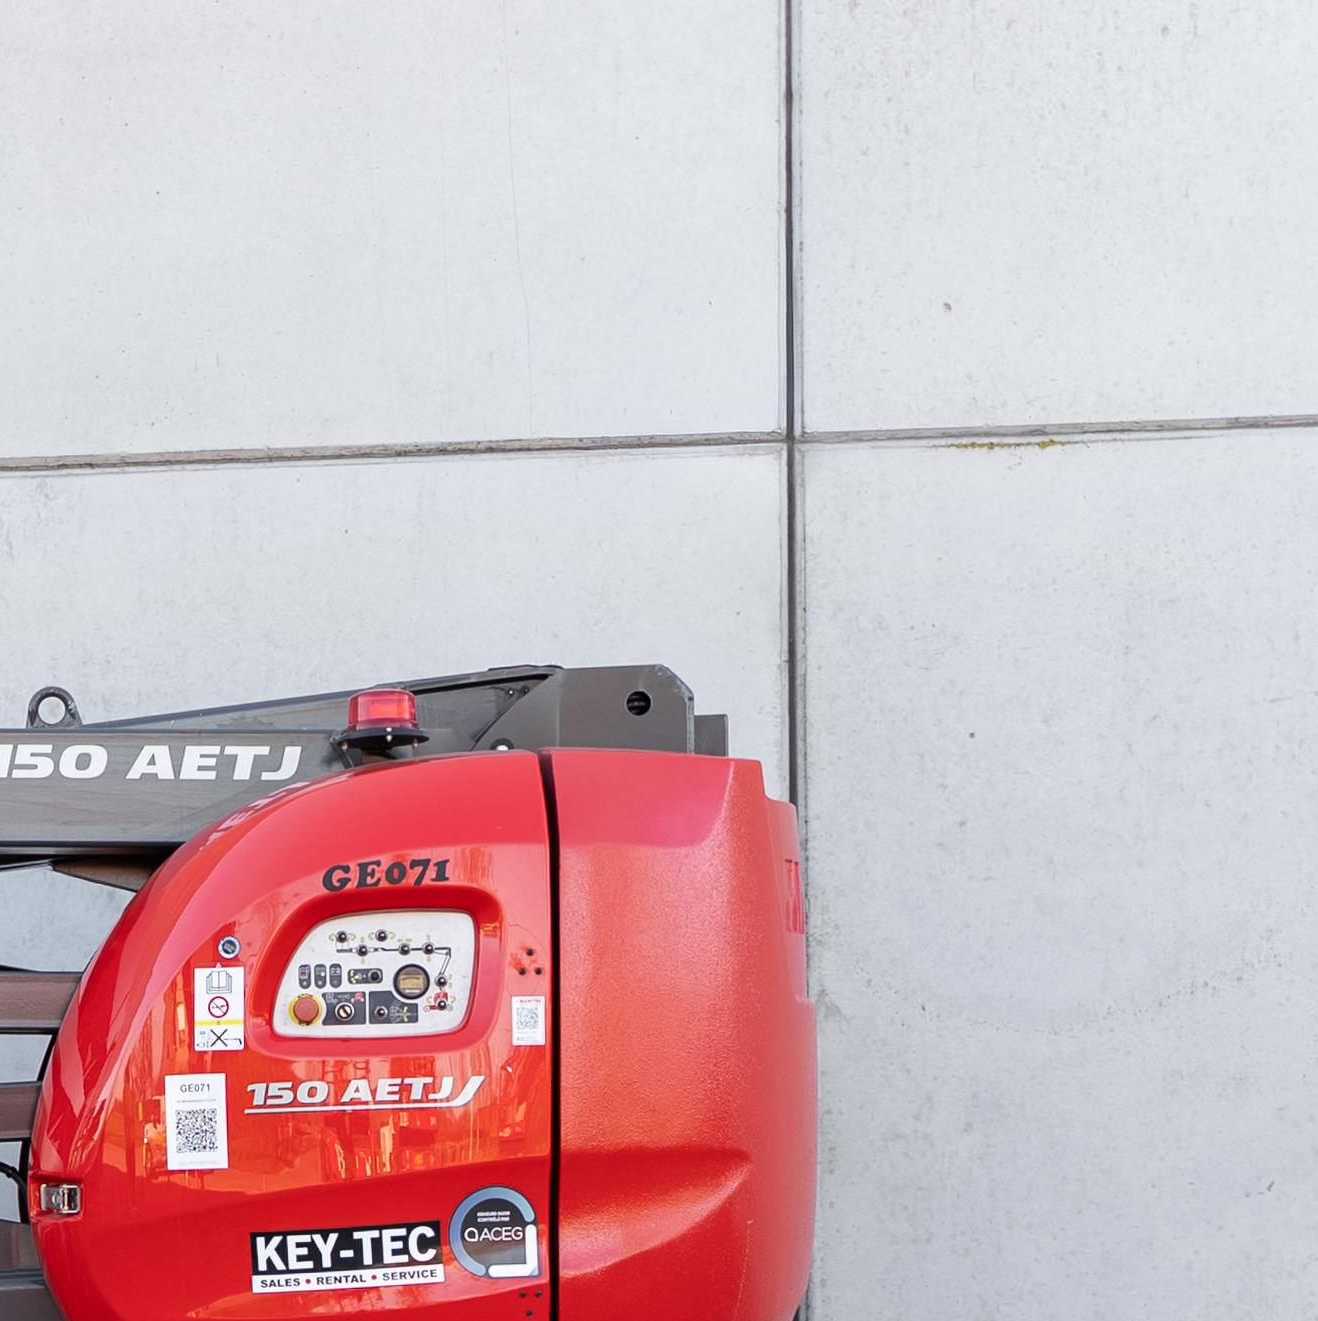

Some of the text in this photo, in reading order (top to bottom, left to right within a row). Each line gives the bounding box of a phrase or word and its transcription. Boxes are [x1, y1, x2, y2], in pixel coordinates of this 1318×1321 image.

[125, 745, 305, 782] AETJ
[322, 858, 450, 892] GE071
[179, 1083, 211, 1093] GE071
[246, 1076, 454, 1106] 150 AETJ
[256, 1226, 437, 1272] KEY-TEC
[479, 1226, 523, 1242] ACEG
[260, 1269, 438, 1288] SALES RENTAL SERVICE
